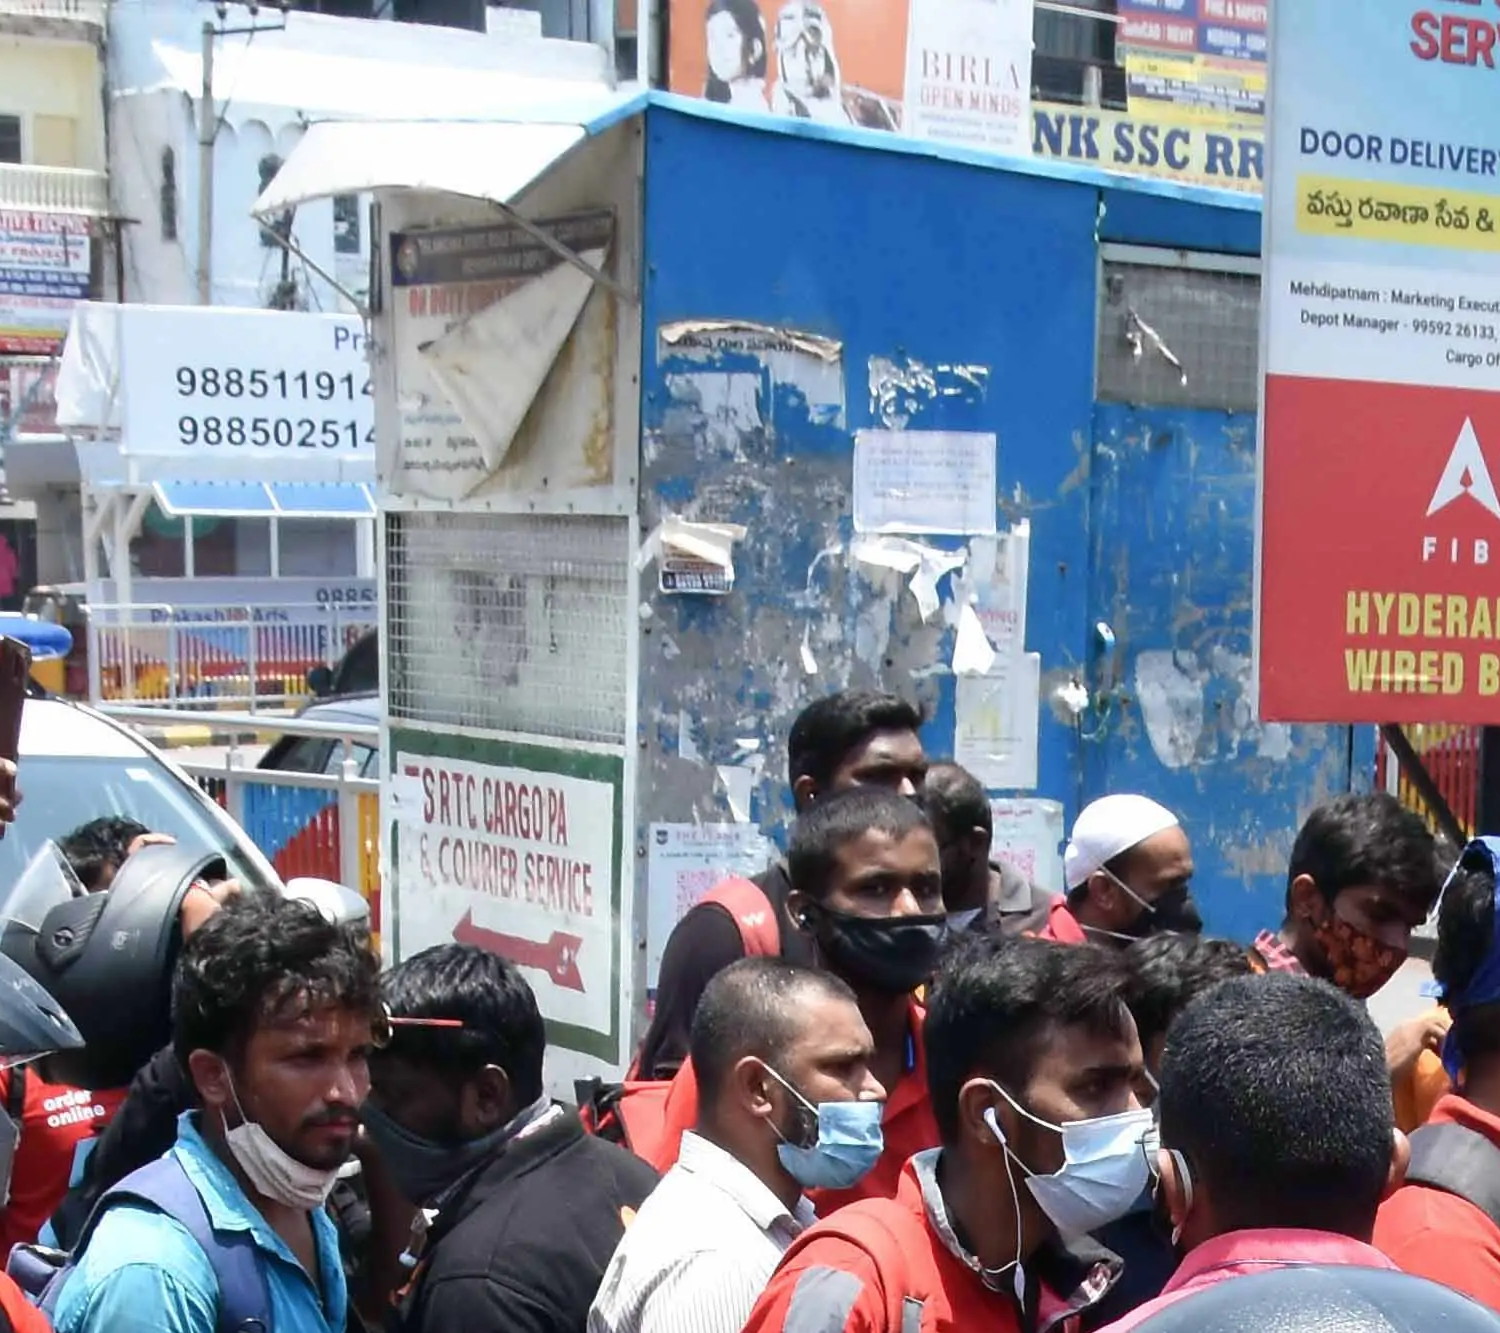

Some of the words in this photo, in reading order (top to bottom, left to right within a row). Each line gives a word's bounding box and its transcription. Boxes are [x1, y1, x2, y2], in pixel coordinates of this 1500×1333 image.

[921, 48, 1020, 89] BIRLA
[919, 83, 964, 110] OPEN
[968, 88, 1022, 119] MINDS
[1113, 123, 1190, 170] SSC
[1299, 127, 1383, 164] DOOR
[1306, 190, 1354, 229] వస్తు
[1357, 199, 1430, 225] రవాణా
[1434, 198, 1470, 230] సేవ
[1475, 209, 1494, 232] &
[1289, 279, 1381, 304] Mehdipatnam
[1389, 289, 1455, 313] Marketing
[1299, 309, 1339, 331] Depot
[1341, 312, 1401, 337] Manager
[1411, 318, 1453, 338] 99592
[1455, 322, 1498, 343] 26133,
[1444, 348, 1484, 370] Cargo
[1344, 648, 1464, 696] WIRED
[405, 765, 477, 831] SRTC
[483, 776, 543, 842] CARGO
[439, 836, 518, 900] COURIER
[524, 852, 593, 917] SERVICE
[43, 1089, 93, 1112] order
[46, 1103, 106, 1128] online
